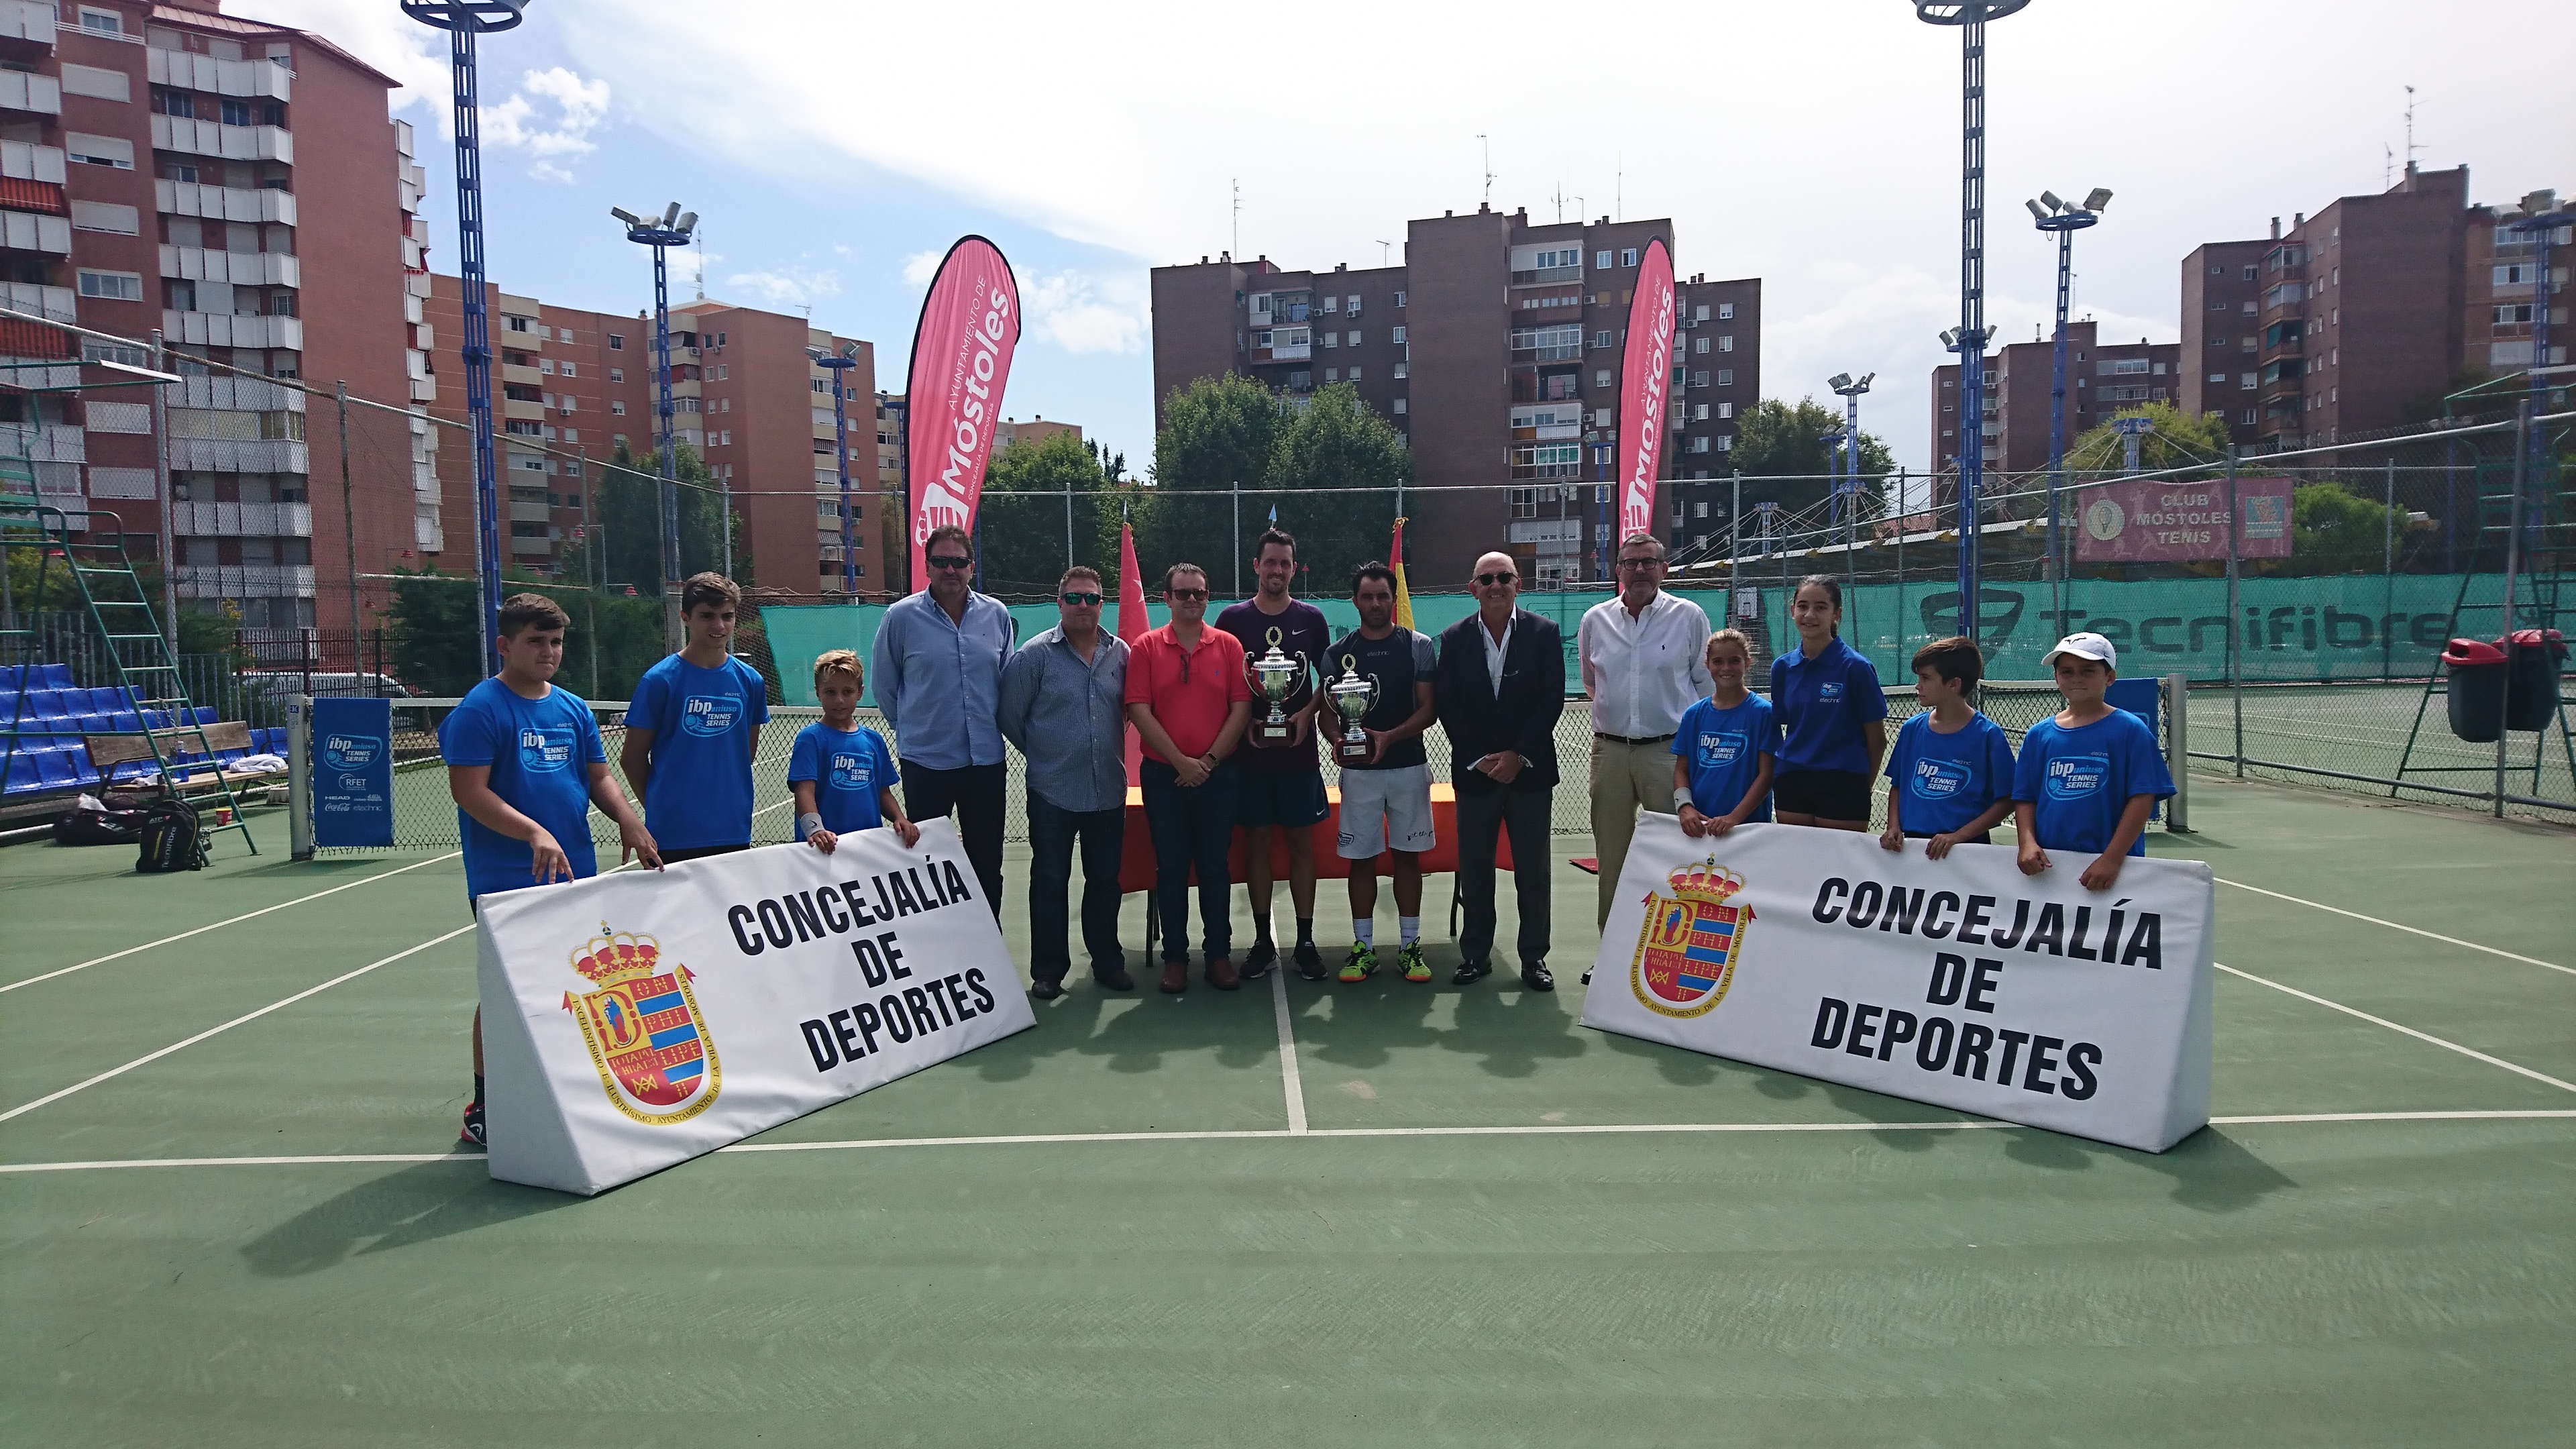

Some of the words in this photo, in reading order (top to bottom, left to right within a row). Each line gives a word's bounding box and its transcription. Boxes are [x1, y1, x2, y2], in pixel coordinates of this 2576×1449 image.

[1655, 274, 1661, 295] DE
[949, 298, 980, 411] AYUNTAMIENTO
[975, 274, 986, 297] DE
[968, 454, 982, 500] CONCEJALÍA
[979, 443, 985, 453] DE
[982, 402, 994, 443] DEPORTES
[2161, 494, 2209, 506] CLUB
[2137, 511, 2231, 525] MÓSTOLES
[2158, 531, 2212, 544] TENIS
[688, 700, 712, 715] ibp
[329, 737, 352, 752] ibp
[523, 732, 545, 749] ibp
[1701, 735, 1720, 749] ibp
[543, 746, 569, 754] TENNIS
[835, 755, 855, 770] ibp
[1917, 761, 1939, 777] ibp
[2050, 761, 2075, 777] ibp
[346, 778, 366, 786] RFET
[1927, 783, 1956, 792] SERIES
[1930, 777, 1957, 786] TENNIS
[728, 855, 973, 956] CONCEJALÍA
[1703, 906, 1729, 920] ON
[1637, 900, 1656, 952] EXCELENTÍSIMO
[1812, 877, 2162, 970] CONCEJALÍA
[1693, 932, 1723, 947] PHI
[850, 931, 913, 989] DE
[1729, 953, 1736, 963] DE
[1684, 961, 1720, 977] LIPE
[1721, 967, 1733, 987] VILLA
[637, 976, 669, 996] ON
[1631, 964, 1648, 1004] ILUSTRÍSIMO
[1926, 951, 2004, 1014] DE
[1715, 991, 1723, 1001] LA
[1649, 1003, 1701, 1017] AYUNTAMIENTO
[1704, 1002, 1714, 1012] DE
[646, 1009, 682, 1030] PHI
[697, 1020, 706, 1032] DE
[799, 967, 996, 1073] DEPORTES
[573, 1000, 604, 1069] EXCELENTÍSIMO
[659, 1041, 702, 1066] LIPE
[704, 1036, 716, 1061] VILLA
[1810, 996, 2102, 1101] DEPORTES
[713, 1067, 720, 1077] LA
[712, 1081, 720, 1093] DE
[606, 1084, 651, 1123] ILUSTRÍSIMO
[657, 1095, 712, 1124] AYUNTAMIENTO
